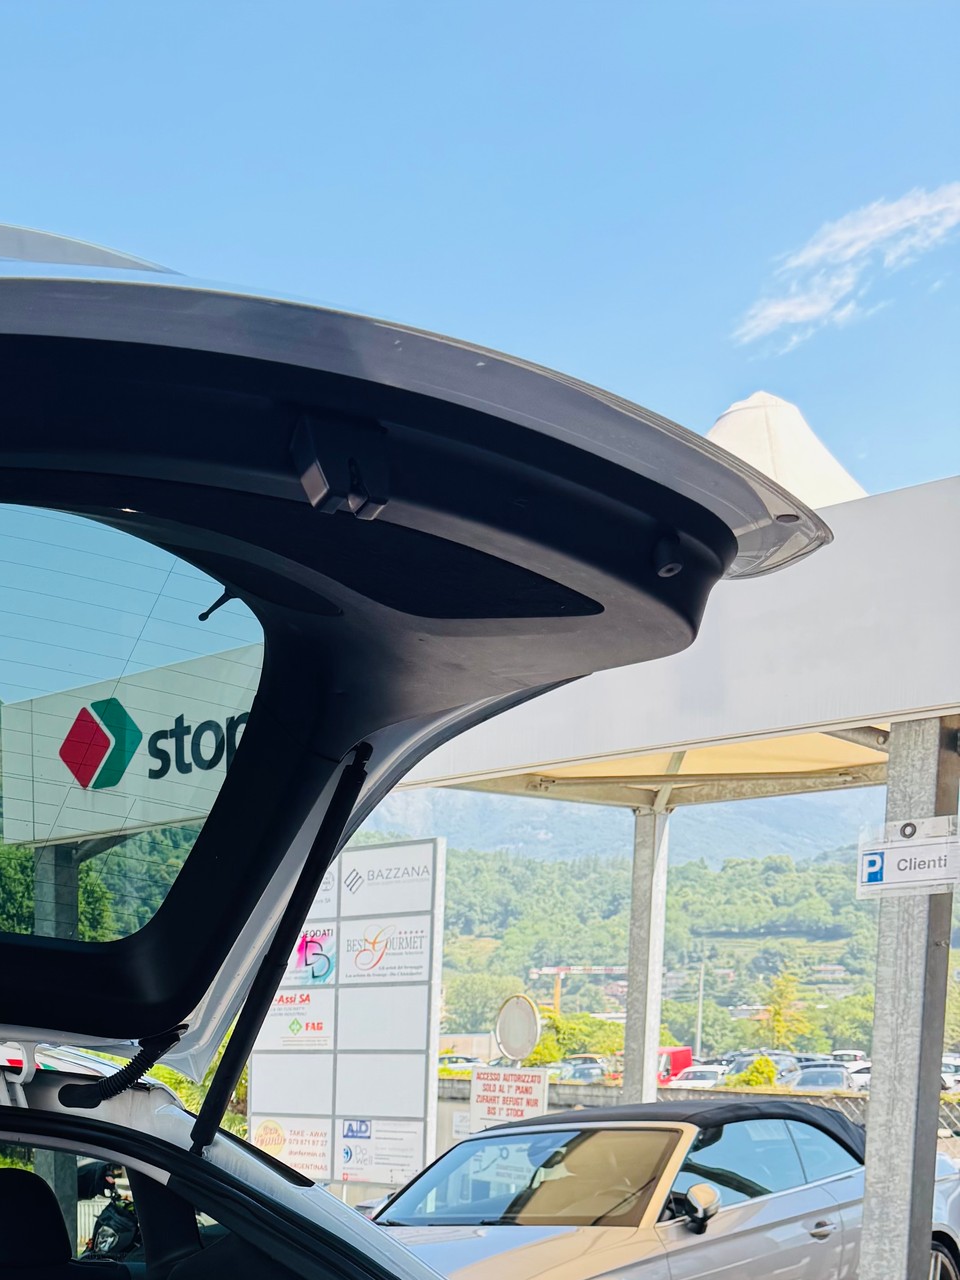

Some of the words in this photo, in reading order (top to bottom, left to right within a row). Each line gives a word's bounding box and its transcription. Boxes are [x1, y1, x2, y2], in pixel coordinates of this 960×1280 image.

[368, 865, 430, 881] BAZZANA
[862, 855, 882, 883] P
[897, 855, 947, 871] Clienti
[346, 938, 367, 952] BEST
[299, 994, 311, 1004] SA
[305, 1022, 323, 1031] FAG
[476, 1072, 500, 1082] ACCESSO
[503, 1073, 541, 1084] AUTORIZZATO
[482, 1084, 496, 1092] SOLO
[498, 1084, 505, 1093] AL
[515, 1086, 533, 1095] PIANO
[476, 1095, 500, 1104] ZUFAHRT
[526, 1098, 539, 1107] NUR
[487, 1107, 496, 1116] BIS
[506, 1108, 525, 1118] STOCK
